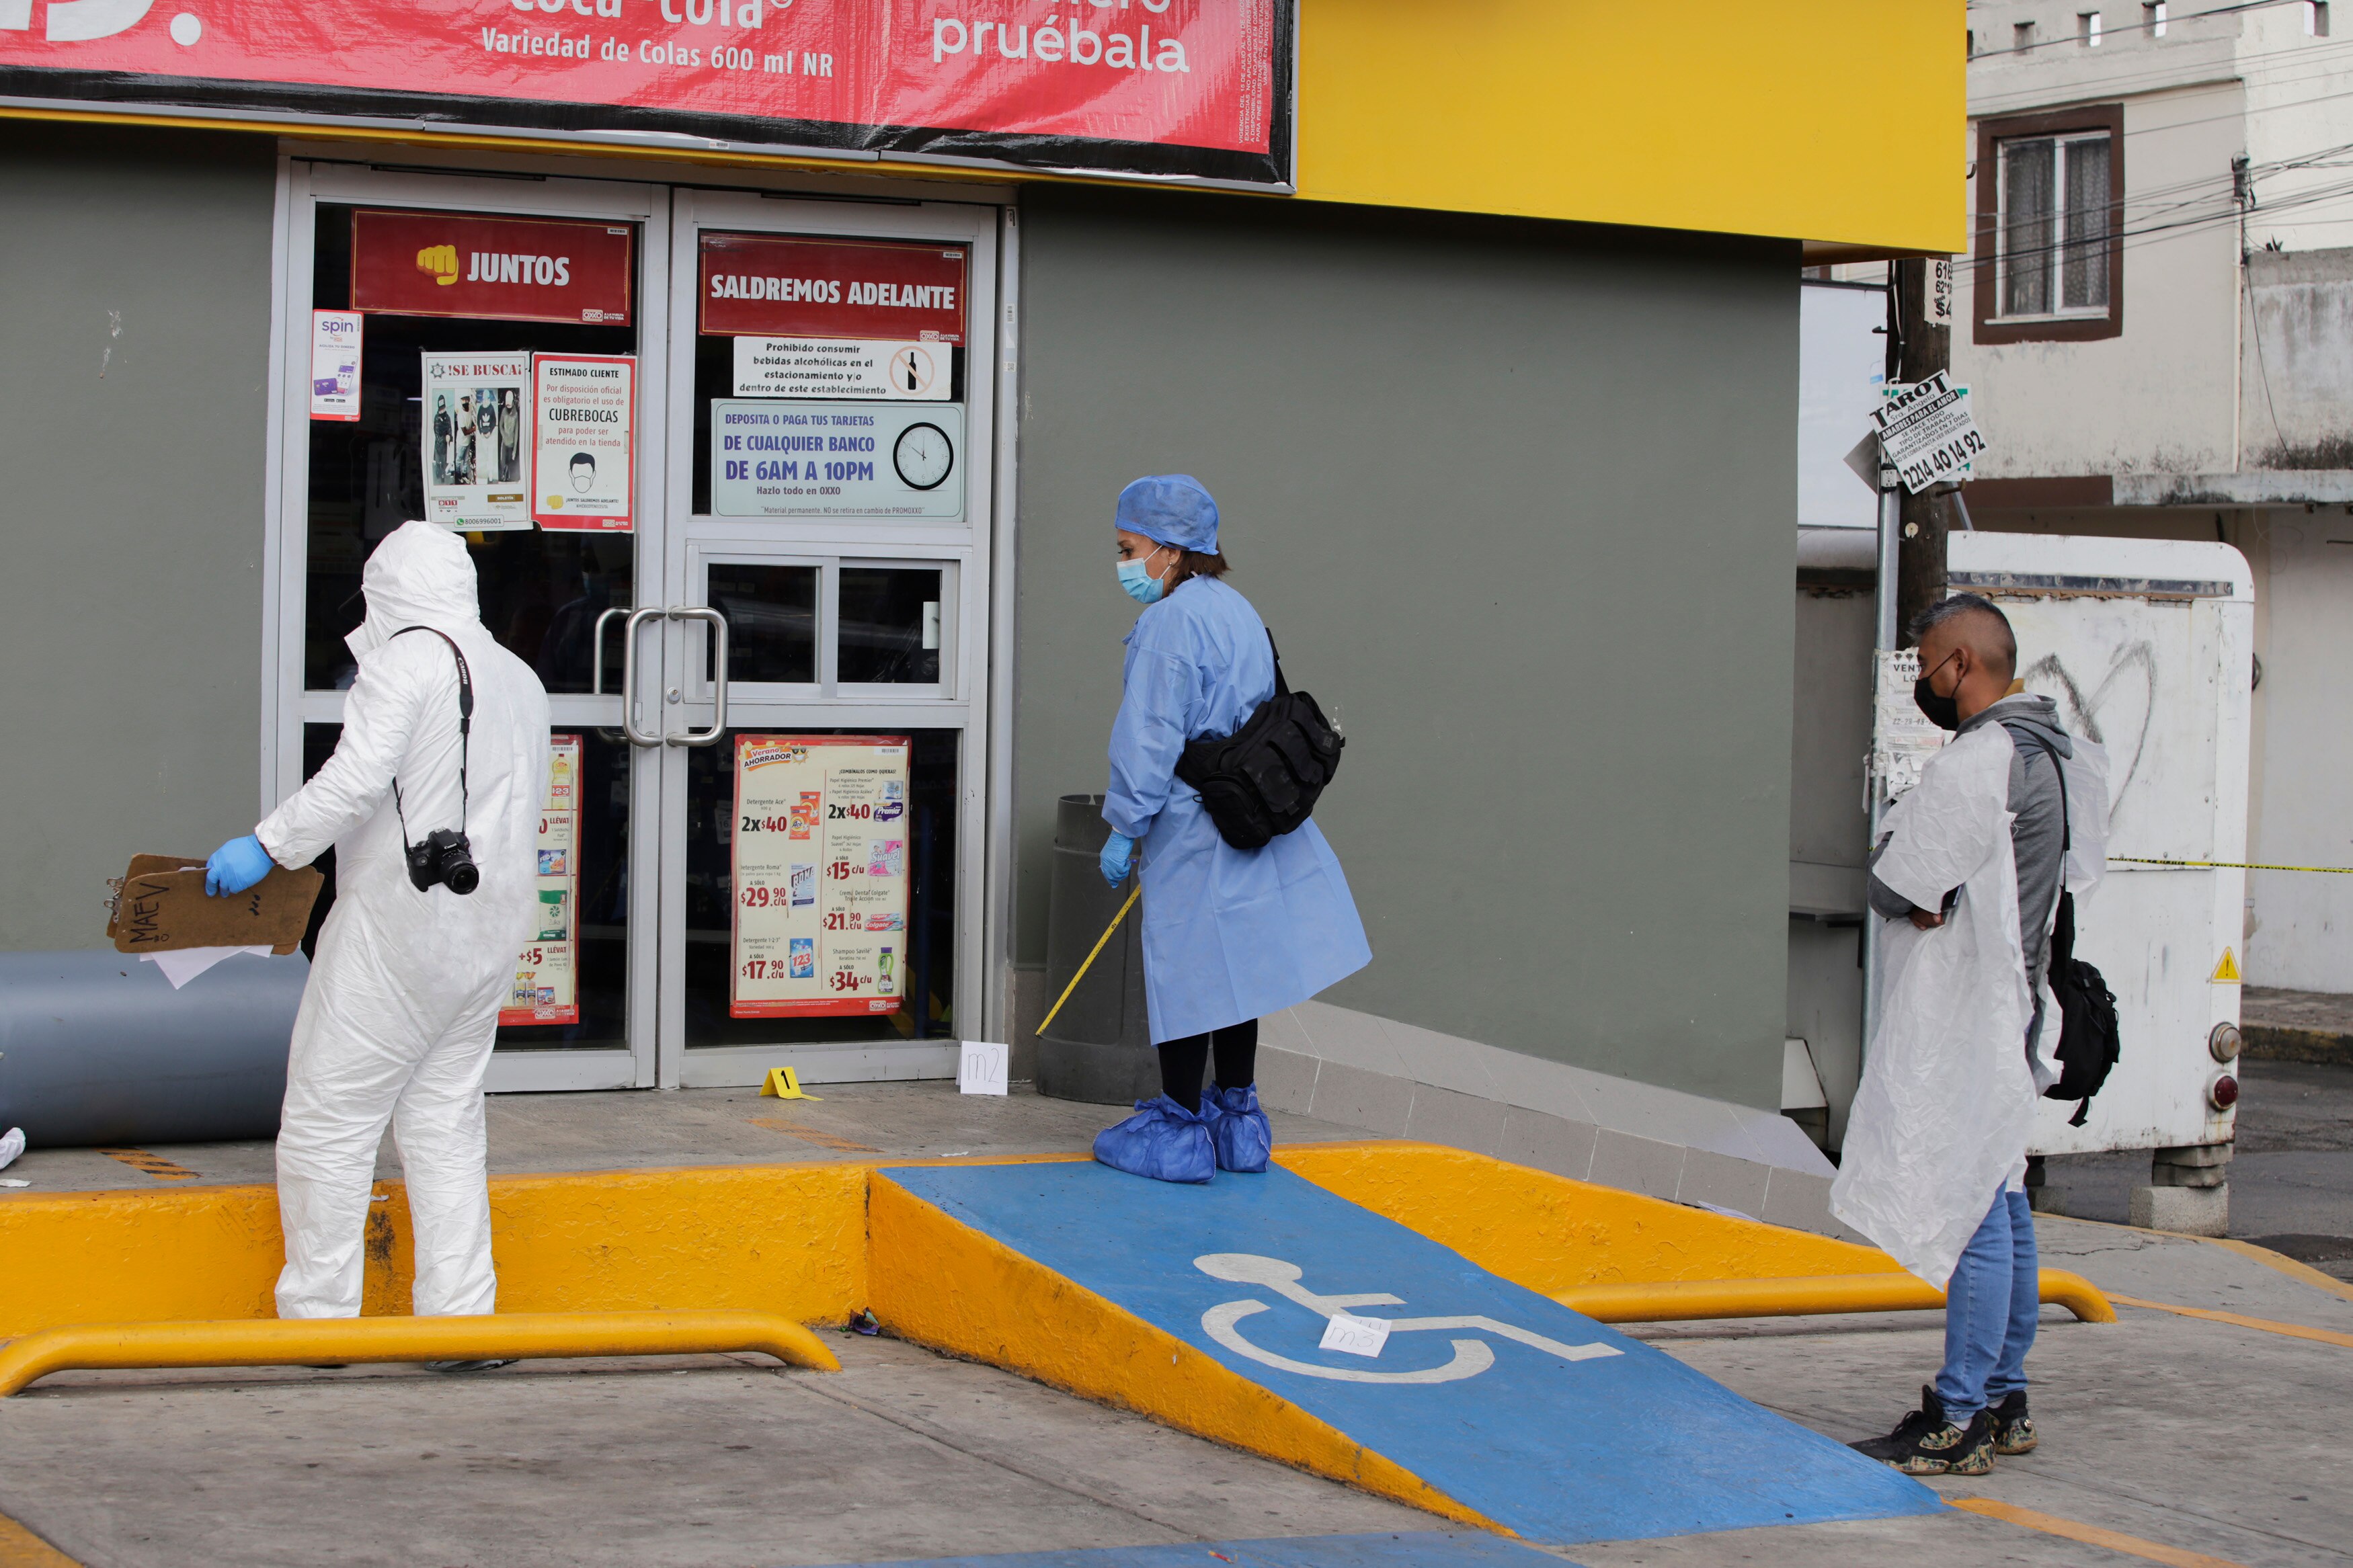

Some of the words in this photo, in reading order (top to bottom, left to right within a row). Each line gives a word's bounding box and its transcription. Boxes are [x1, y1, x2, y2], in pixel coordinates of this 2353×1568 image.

[1240, 19, 1245, 28] DE
[1253, 27, 1257, 36] EN
[1263, 48, 1267, 57] EN
[1265, 11, 1269, 19] DE
[933, 14, 1190, 73] pruébala
[1241, 41, 1245, 49] AL
[482, 27, 590, 59] Variedad
[601, 37, 629, 62] de
[640, 40, 700, 67] Colas
[711, 46, 753, 71] 600
[764, 50, 792, 75] ml
[804, 53, 834, 77] NR
[1241, 73, 1245, 82] DE
[1253, 65, 1257, 75] NO
[1246, 80, 1250, 90] NO
[467, 251, 569, 286] JUNTOS
[711, 274, 840, 304] SALDREMOS
[846, 281, 955, 310] ADELANTE
[584, 311, 602, 321] OXXO
[322, 319, 354, 334] spin
[921, 331, 939, 341] OXXO
[766, 343, 813, 354] Prohibido
[817, 344, 861, 354] consumir
[753, 356, 791, 366] bebidas
[794, 357, 847, 367] alcohólicas
[850, 360, 862, 368] en
[864, 358, 873, 368] el
[550, 368, 588, 377] ESTIMADO
[590, 369, 619, 378] CLIENTE
[764, 371, 844, 381] estacionamiento
[846, 372, 862, 382] y/o
[547, 384, 559, 393] Por
[560, 384, 599, 395] disposición
[600, 386, 622, 395] oficial
[739, 384, 772, 393] dentro
[774, 384, 786, 393] de
[789, 385, 808, 394] este
[811, 384, 886, 395] establecimiento
[553, 395, 591, 406] obligatorio
[1869, 372, 1948, 428] TAROT
[549, 408, 618, 423] CUBREBOCAS
[1890, 411, 1906, 422] Sra.
[1907, 394, 1936, 413] Angela
[725, 414, 770, 425] DEPOSITA
[772, 415, 780, 425] O
[783, 415, 807, 425] PAGA
[811, 415, 828, 425] TUS
[831, 415, 874, 426] TARJETAS
[1882, 418, 1911, 440] AMARRES
[1911, 407, 1929, 424] PARA
[1929, 403, 1938, 413] EL
[1938, 393, 1956, 409] AMOR
[1909, 421, 1927, 434] HACE
[1927, 410, 1945, 423] TODO
[575, 427, 596, 436] poder
[1892, 430, 1938, 458] GARANTIZADOS
[1953, 411, 1968, 423] DIAS
[1899, 437, 1913, 447] TIPO
[1922, 412, 1954, 434] TRABAJOS
[1907, 446, 1923, 457] COBRA
[1922, 438, 1936, 450] HASTA
[1936, 431, 1944, 442] VER
[1944, 417, 1971, 436] RESULTADOS
[545, 438, 576, 446] atendido
[590, 438, 596, 446] la
[598, 439, 621, 447] tienda
[724, 435, 742, 451] DE
[747, 436, 824, 454] CUALQUIER
[828, 436, 875, 452] BANCO
[1903, 458, 1935, 489] 2214
[1932, 449, 1952, 472] 40
[1948, 440, 1967, 463] 14
[1963, 430, 1986, 454] 92
[725, 460, 749, 480] DE
[756, 460, 798, 481] 6AM
[804, 461, 818, 481] A
[824, 461, 874, 481] 10PM
[756, 486, 781, 495] Hazlo
[783, 486, 803, 495] todo
[820, 487, 841, 495] OXXO
[788, 507, 822, 515] permanente.
[864, 507, 883, 515] cambio
[884, 507, 891, 515] de
[456, 657, 469, 685] Canon
[752, 747, 780, 757] Verano
[744, 753, 791, 768] AHORRADOR
[828, 804, 871, 819] 2x$40
[877, 807, 901, 815] Premier
[742, 816, 787, 832] 2x$40
[871, 848, 901, 864] Suavel
[827, 862, 850, 880] $15
[852, 865, 864, 874] c/u
[130, 882, 169, 944] MAEV
[518, 948, 543, 965] +$5
[793, 953, 811, 966] 123
[830, 972, 859, 991] $34
[861, 975, 872, 983] c/u
[781, 1070, 790, 1089] 1
